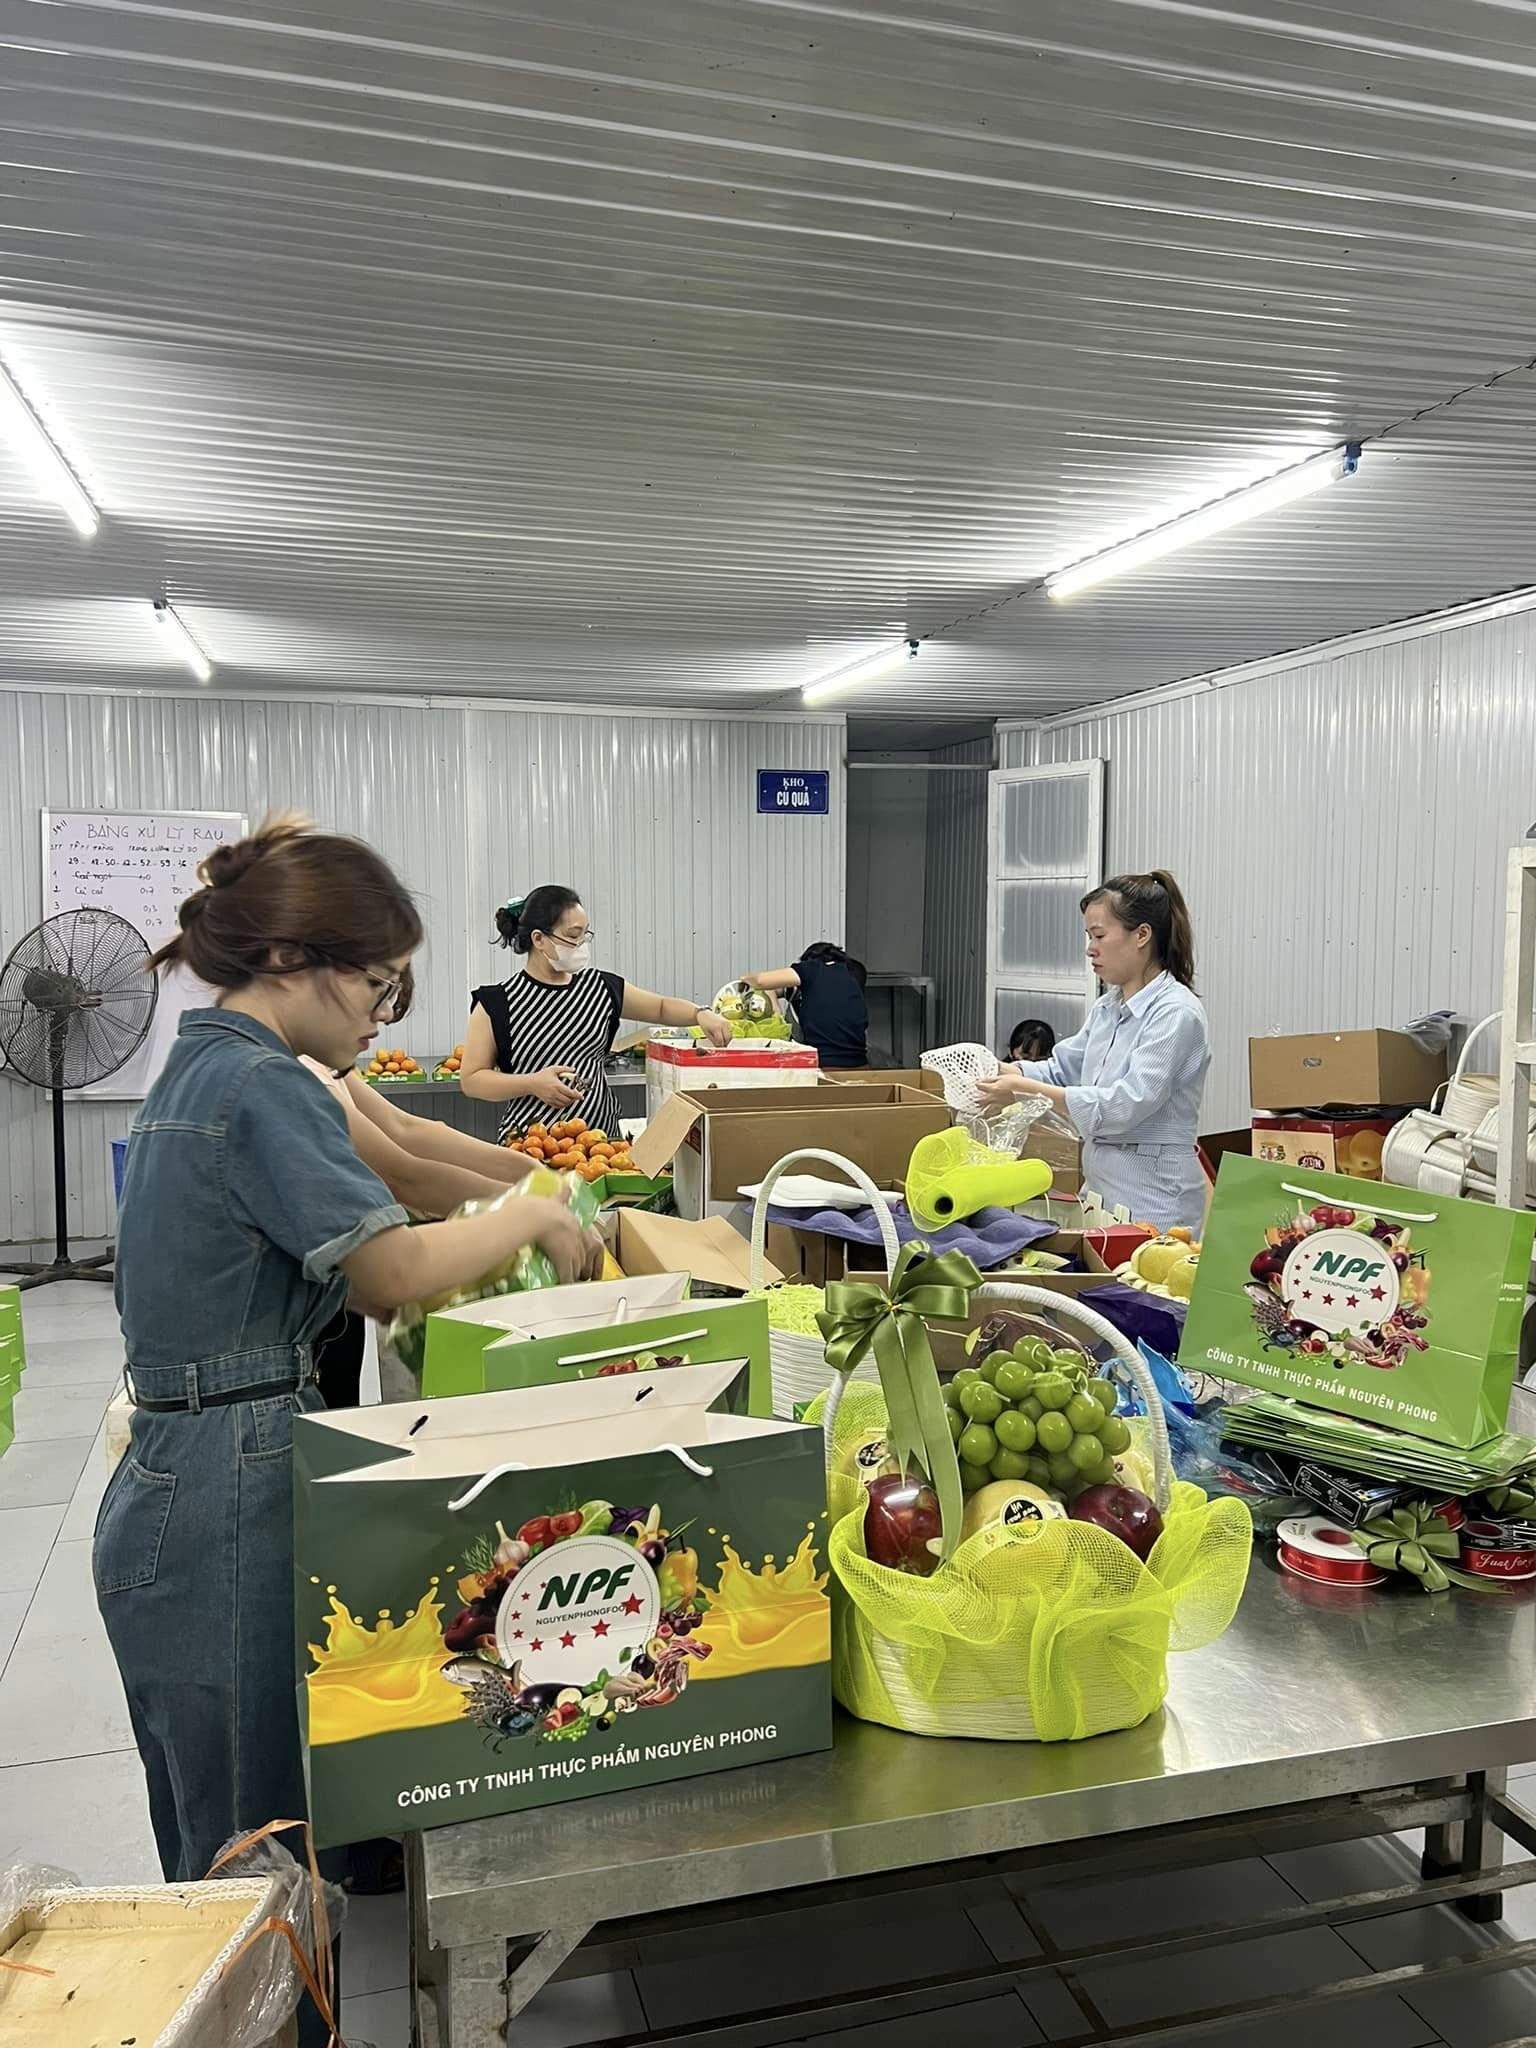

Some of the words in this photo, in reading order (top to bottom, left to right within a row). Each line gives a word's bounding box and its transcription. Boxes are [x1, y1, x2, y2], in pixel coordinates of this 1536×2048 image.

[783, 777, 804, 787] KHO
[776, 786, 789, 806] CỦ
[791, 786, 810, 807] QUẢ
[193, 827, 224, 841] RAU
[1312, 1250, 1386, 1283] NPF
[1206, 1347, 1234, 1364] CÔNG
[1236, 1356, 1250, 1369] TY
[1251, 1360, 1281, 1378] TNHH
[1283, 1369, 1312, 1387] THỰC
[1348, 1387, 1394, 1411] NGUYÊN
[1397, 1401, 1438, 1423] PHONG
[537, 1564, 635, 1611] NPF
[535, 1605, 625, 1626] NGUYENPHONGFOO
[397, 1783, 451, 1807] CÔNG
[456, 1778, 480, 1795] TY
[484, 1767, 534, 1790] TNHH
[538, 1757, 587, 1779] THỰC
[591, 1743, 640, 1770] PHẨM
[645, 1734, 714, 1761] NGUYÊN
[719, 1724, 777, 1748] PHONG
